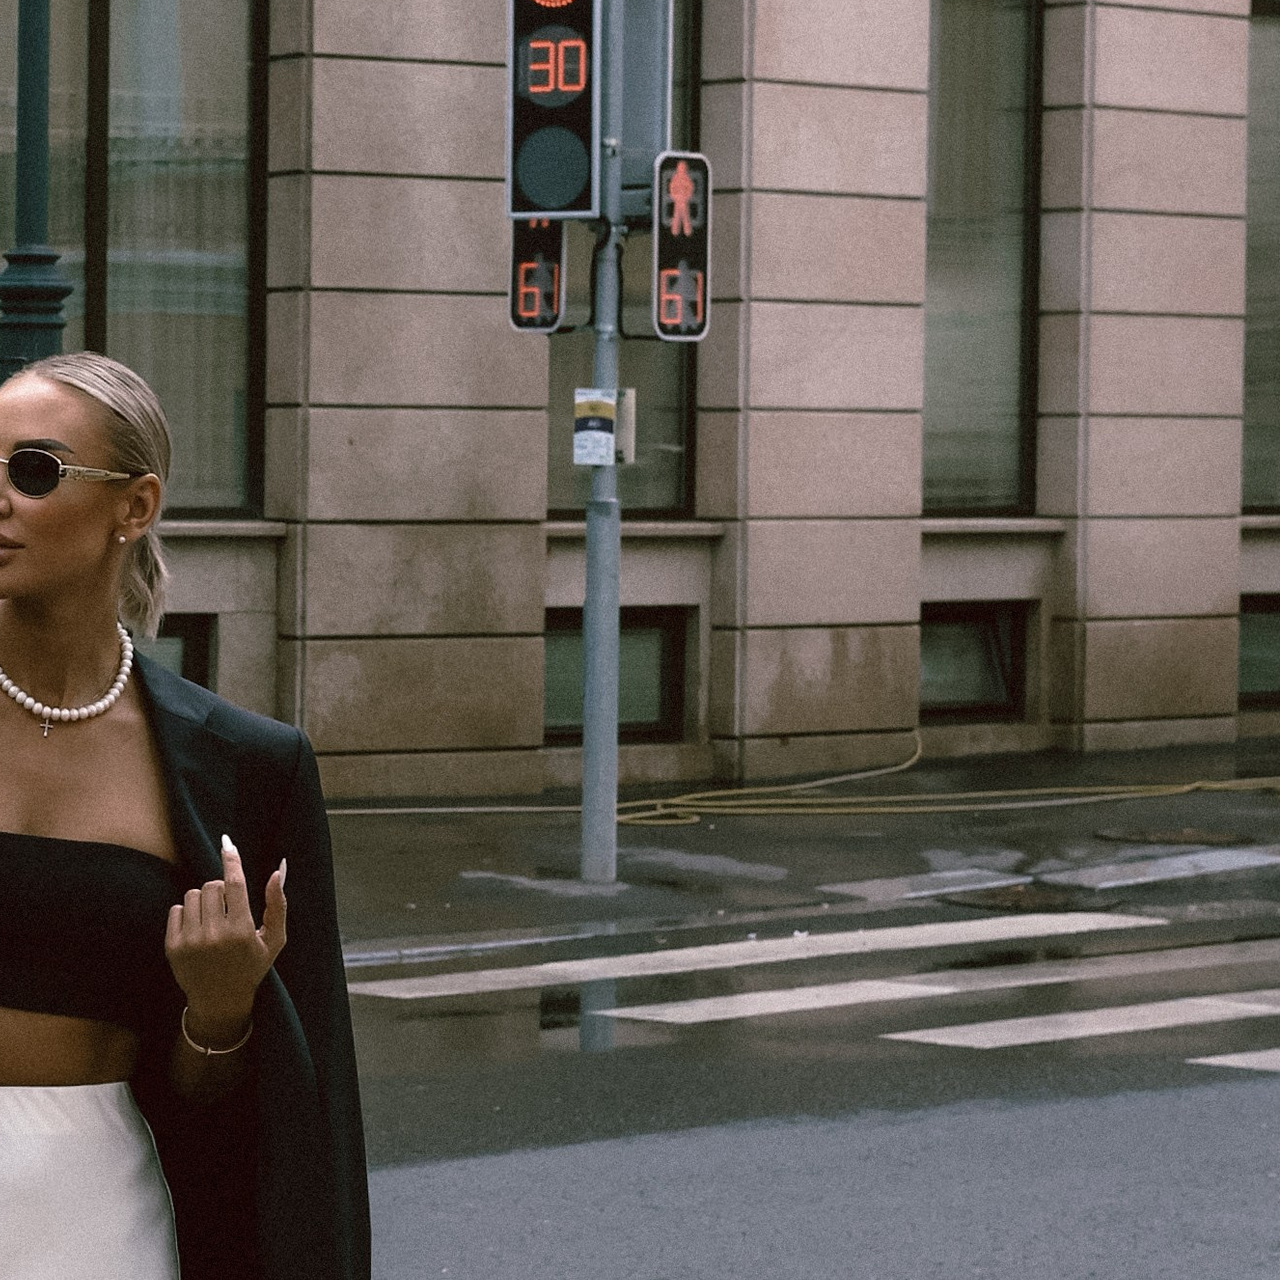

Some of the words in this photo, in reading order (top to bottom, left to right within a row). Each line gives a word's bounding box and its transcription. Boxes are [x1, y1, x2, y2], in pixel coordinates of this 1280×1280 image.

[528, 39, 587, 93] 30
[518, 261, 560, 317] 61
[659, 268, 703, 325] 61
